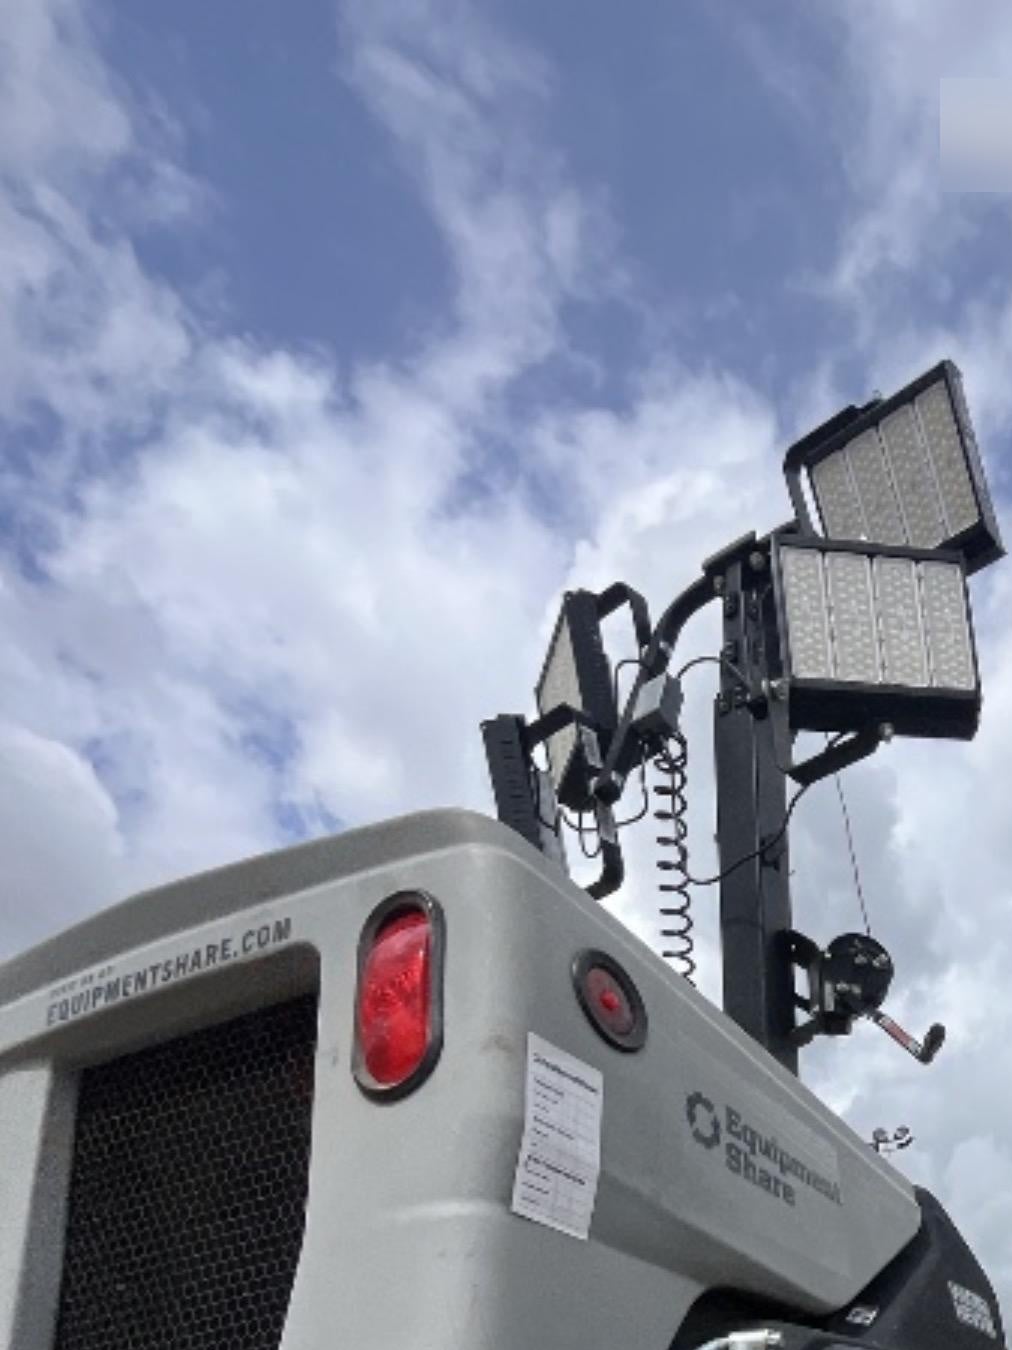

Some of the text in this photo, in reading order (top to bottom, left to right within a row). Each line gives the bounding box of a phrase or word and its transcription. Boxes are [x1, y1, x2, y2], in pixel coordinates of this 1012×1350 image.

[47, 917, 292, 1025] EQUIPMENTSHARE.COM
[726, 1104, 842, 1207] Equipment
[726, 1141, 797, 1207] Share
